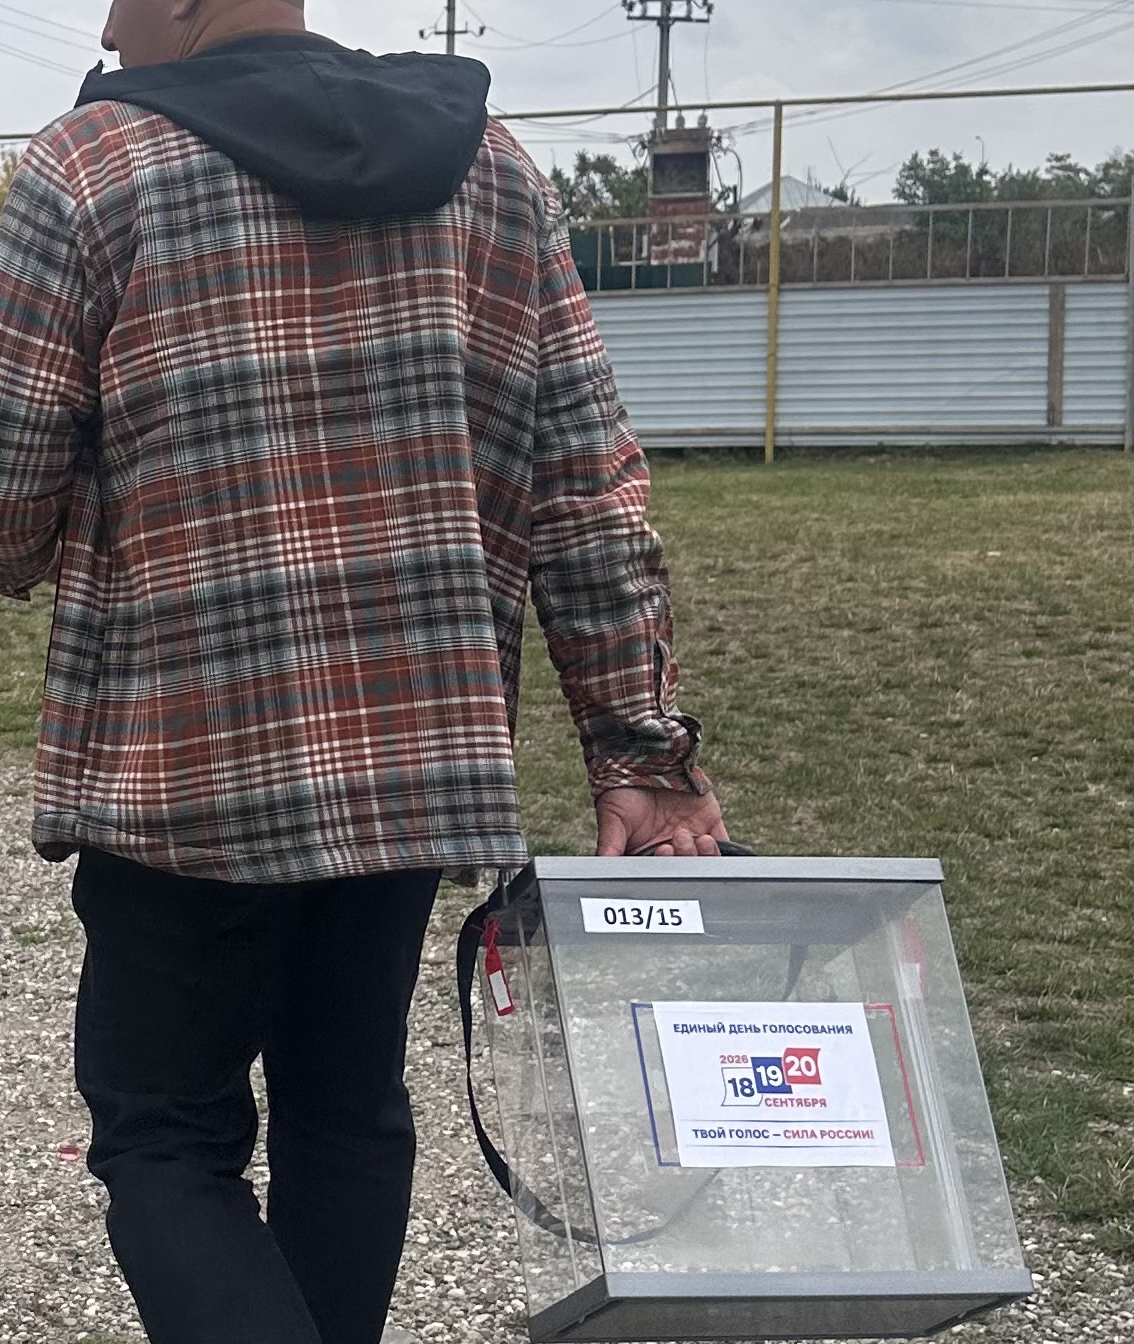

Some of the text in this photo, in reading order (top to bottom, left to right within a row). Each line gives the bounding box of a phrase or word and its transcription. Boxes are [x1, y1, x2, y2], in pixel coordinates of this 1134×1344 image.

[603, 906, 683, 930] 013/15
[673, 1022, 853, 1035] ЕДИНЫЙ ДЕНЬ ГОЛОСОВАНИЯ
[719, 1054, 749, 1064] 2026
[727, 1055, 817, 1098] 18 19 20
[764, 1097, 827, 1108] СЕНТЯБРЯ
[691, 1127, 726, 1139] ТВОЙ
[729, 1129, 770, 1139] ГОЛОС
[783, 1129, 818, 1140] СИЛА
[820, 1128, 875, 1140] РОССИИ!
